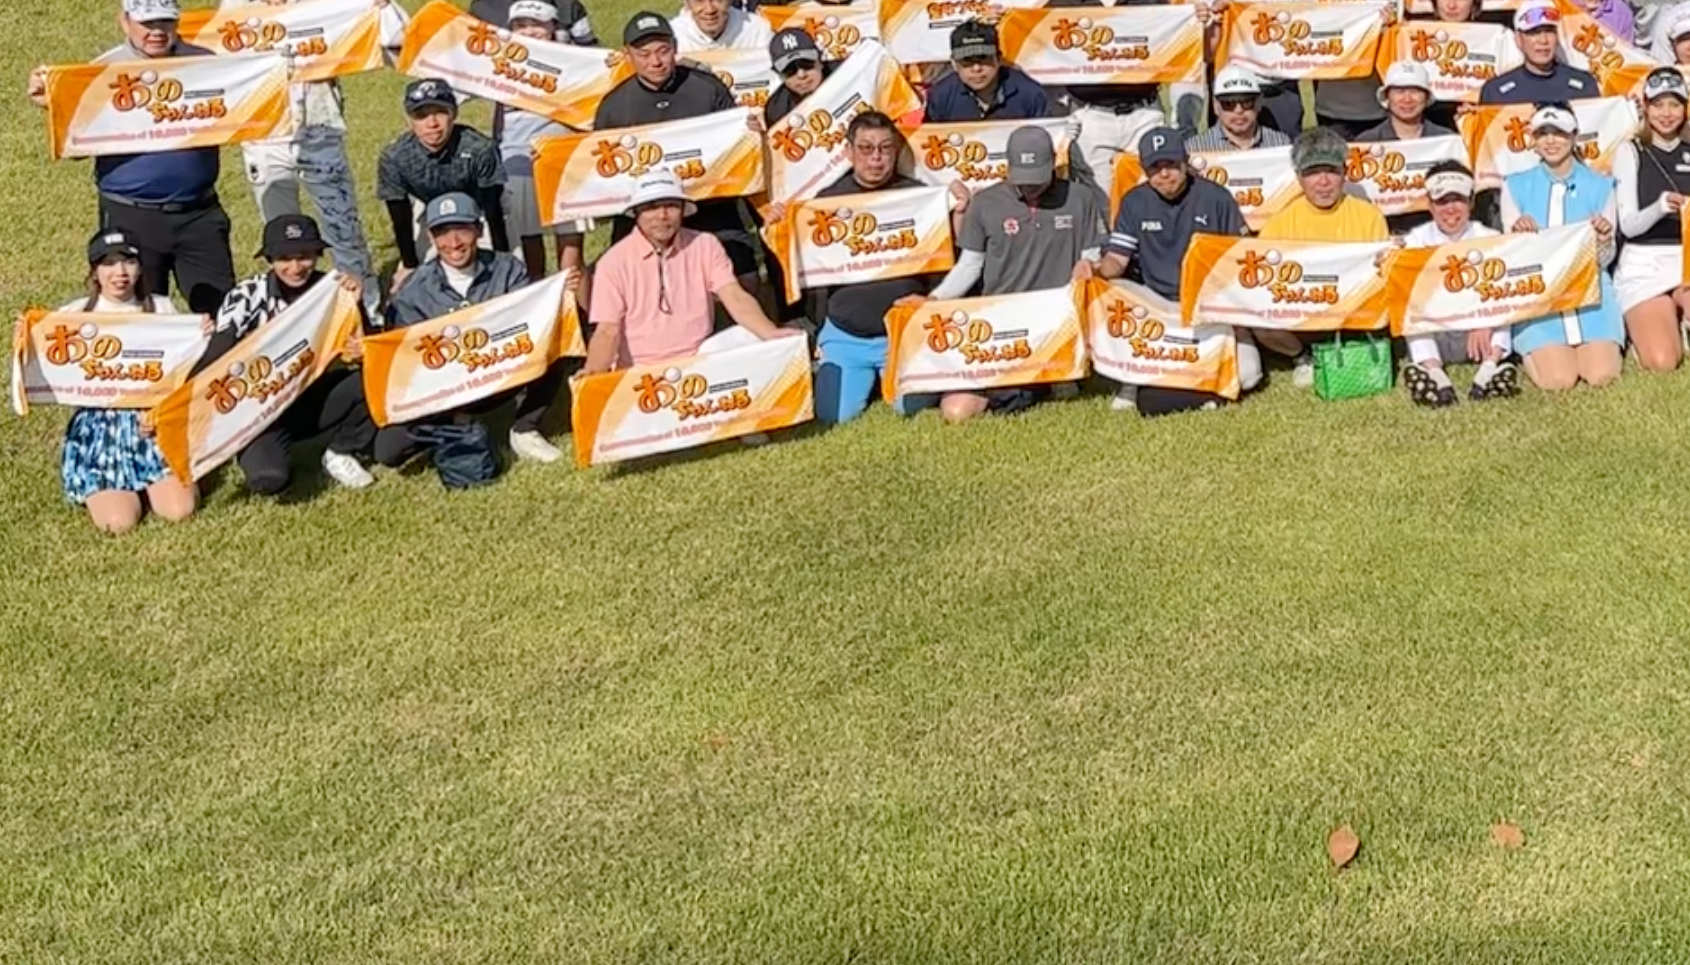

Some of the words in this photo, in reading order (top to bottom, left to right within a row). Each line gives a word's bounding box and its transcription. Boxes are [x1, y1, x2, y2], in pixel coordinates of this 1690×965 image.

[466, 21, 528, 62] おの
[1051, 17, 1114, 50] おの
[1251, 11, 1311, 46] おの
[110, 70, 183, 111] おの
[772, 109, 832, 161] おの
[921, 133, 987, 170] おの
[1152, 135, 1165, 151] P
[591, 135, 662, 177] おの
[1345, 145, 1405, 182] おの
[808, 207, 877, 247] おの
[1237, 249, 1303, 287] おの
[1440, 249, 1505, 293] おの
[46, 323, 122, 365] おの
[415, 326, 488, 369] おの
[923, 309, 992, 353] おの
[204, 355, 272, 413] おの
[634, 367, 708, 413] おの
